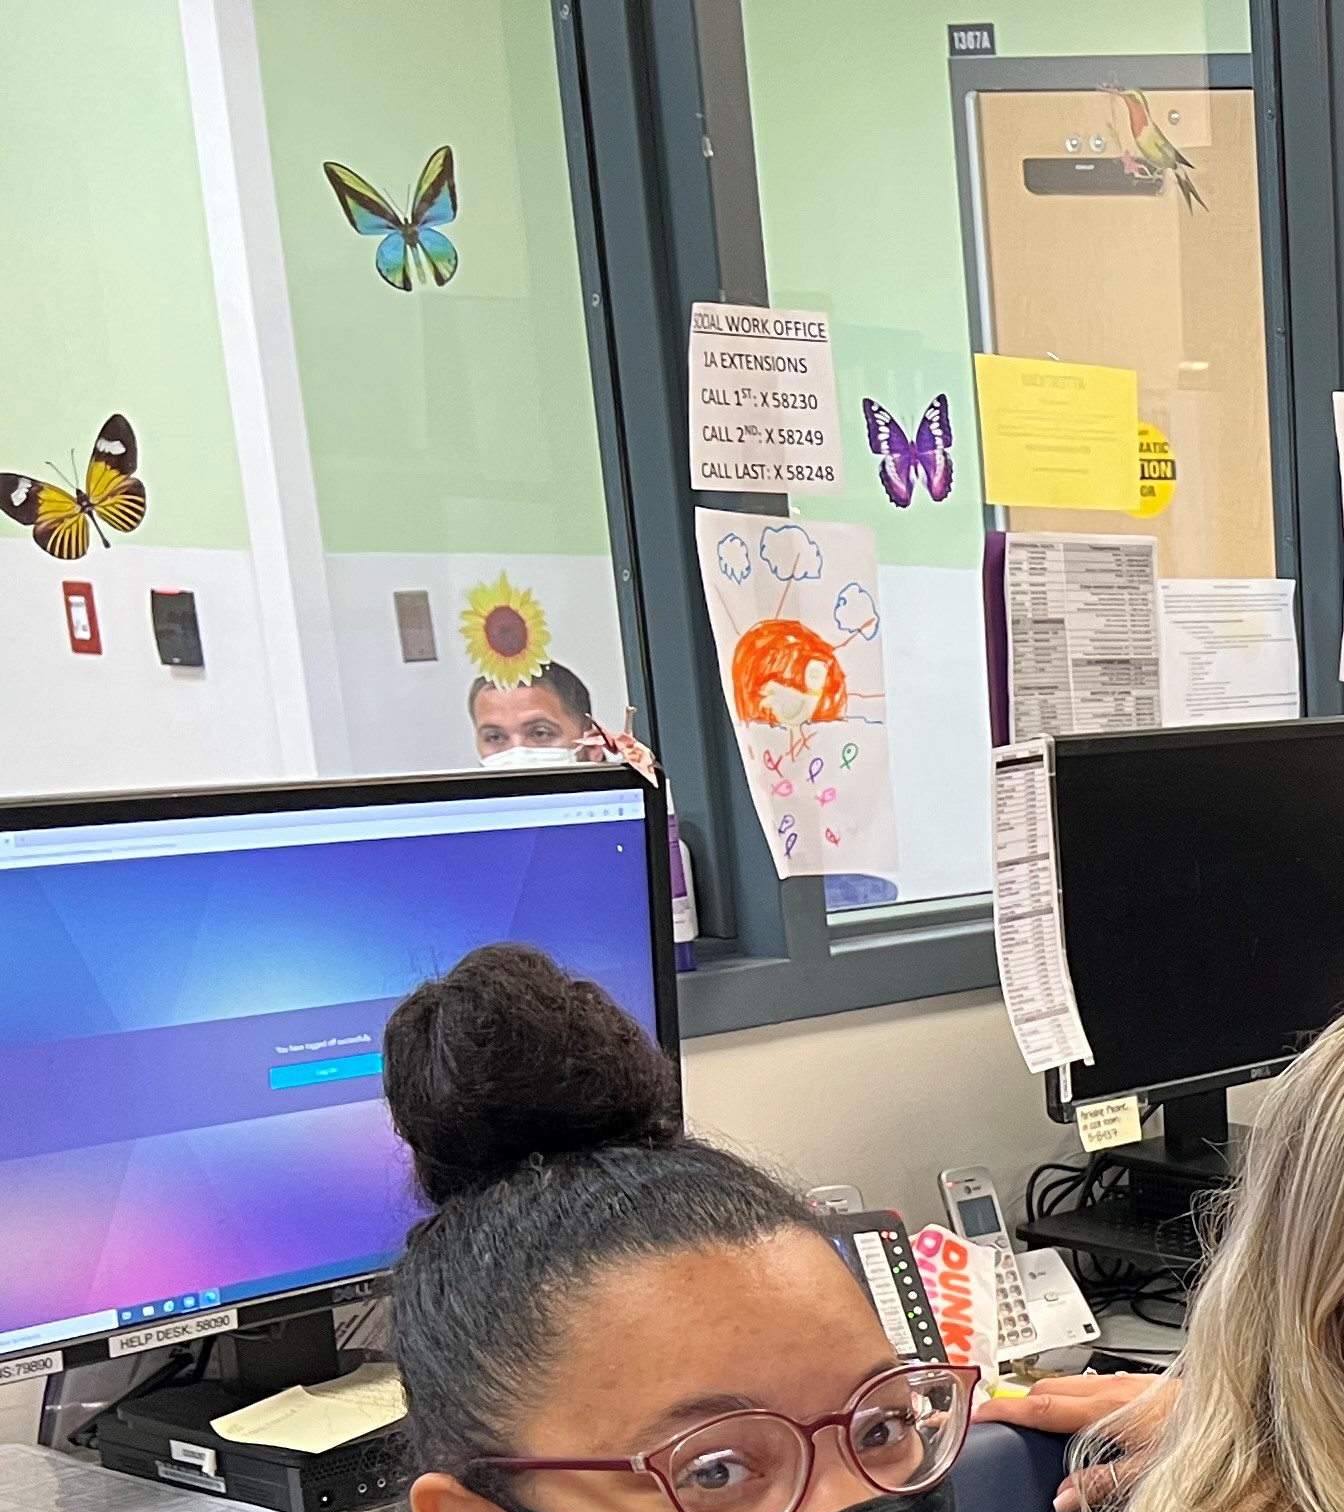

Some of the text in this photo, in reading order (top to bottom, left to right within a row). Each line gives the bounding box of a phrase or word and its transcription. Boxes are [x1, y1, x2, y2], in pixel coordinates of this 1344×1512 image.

[694, 313, 826, 339] SOCIAL WORK OFFICE
[704, 351, 808, 374] 1A EXTENSIONS
[701, 388, 730, 406] CALL
[760, 392, 770, 408] X
[772, 392, 818, 410] 58230
[702, 425, 734, 443] CALL
[765, 428, 775, 445] X
[778, 429, 824, 446] 58249
[701, 462, 835, 482] CALL LAST: X 58248
[120, 1314, 230, 1350] HELP DESK: 58090
